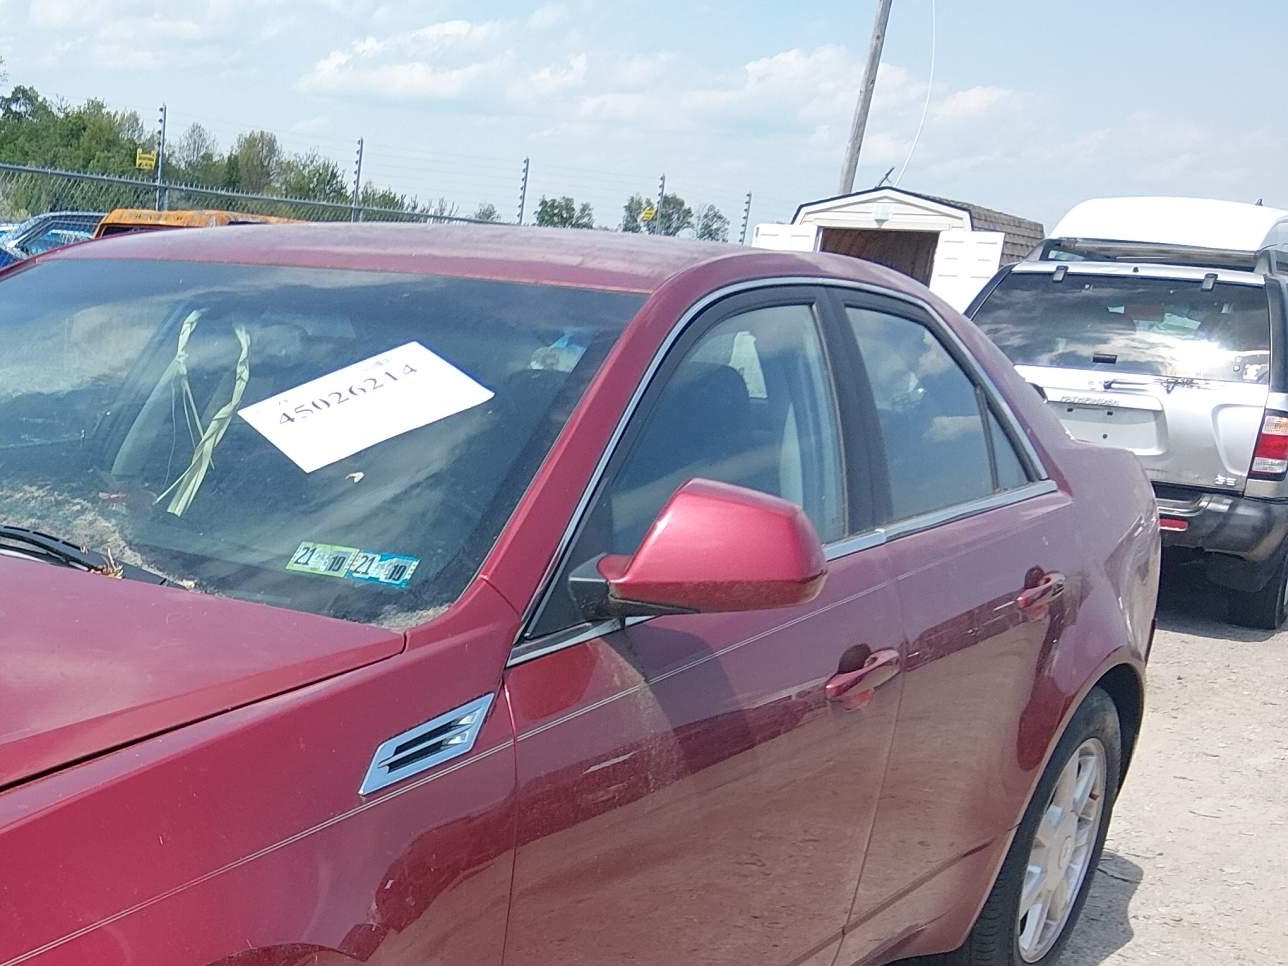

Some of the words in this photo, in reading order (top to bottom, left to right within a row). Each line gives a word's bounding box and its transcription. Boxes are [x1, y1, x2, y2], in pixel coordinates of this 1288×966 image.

[279, 364, 418, 425] 45026214
[294, 546, 317, 566] 21
[354, 555, 376, 576] 21
